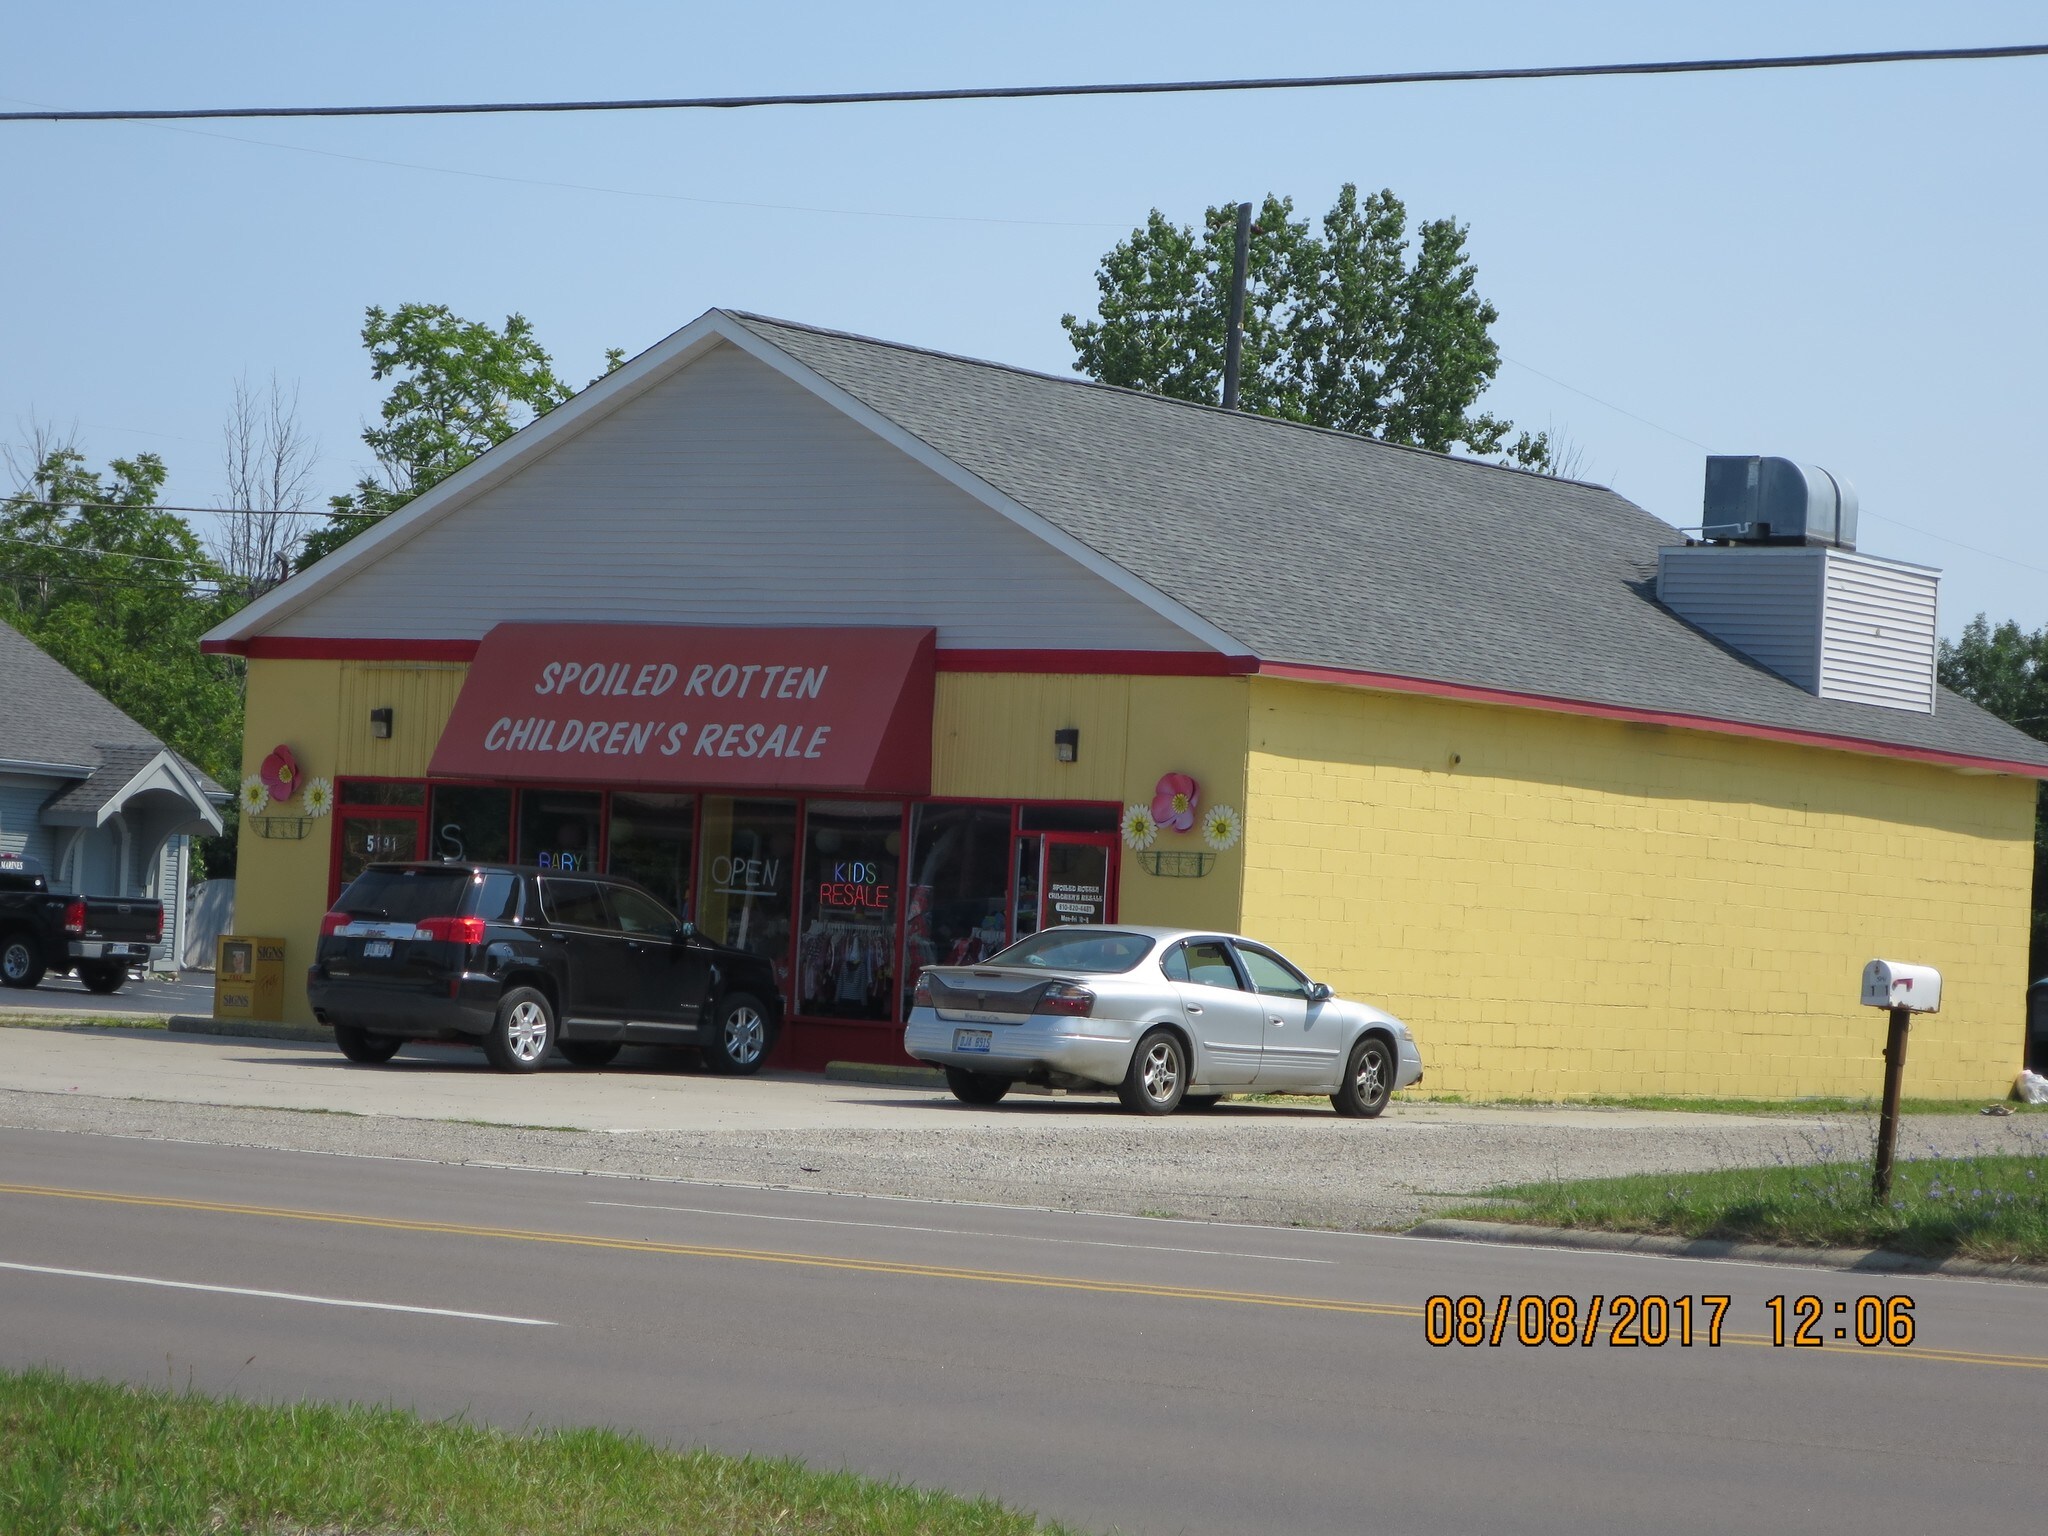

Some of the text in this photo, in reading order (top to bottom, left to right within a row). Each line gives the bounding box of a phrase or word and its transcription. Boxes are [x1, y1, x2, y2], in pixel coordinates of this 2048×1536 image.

[535, 662, 828, 699] SPOILED ROTTEN
[484, 717, 831, 758] CHILDREN'S RESALE
[0, 861, 24, 870] MARINES
[539, 851, 583, 871] BABY
[712, 856, 779, 887] OPEN
[834, 862, 877, 884] KIDS
[819, 883, 889, 908] RESALE
[367, 928, 386, 937] GMC
[257, 946, 283, 960] SIGNS
[223, 994, 249, 1006] SIGNS
